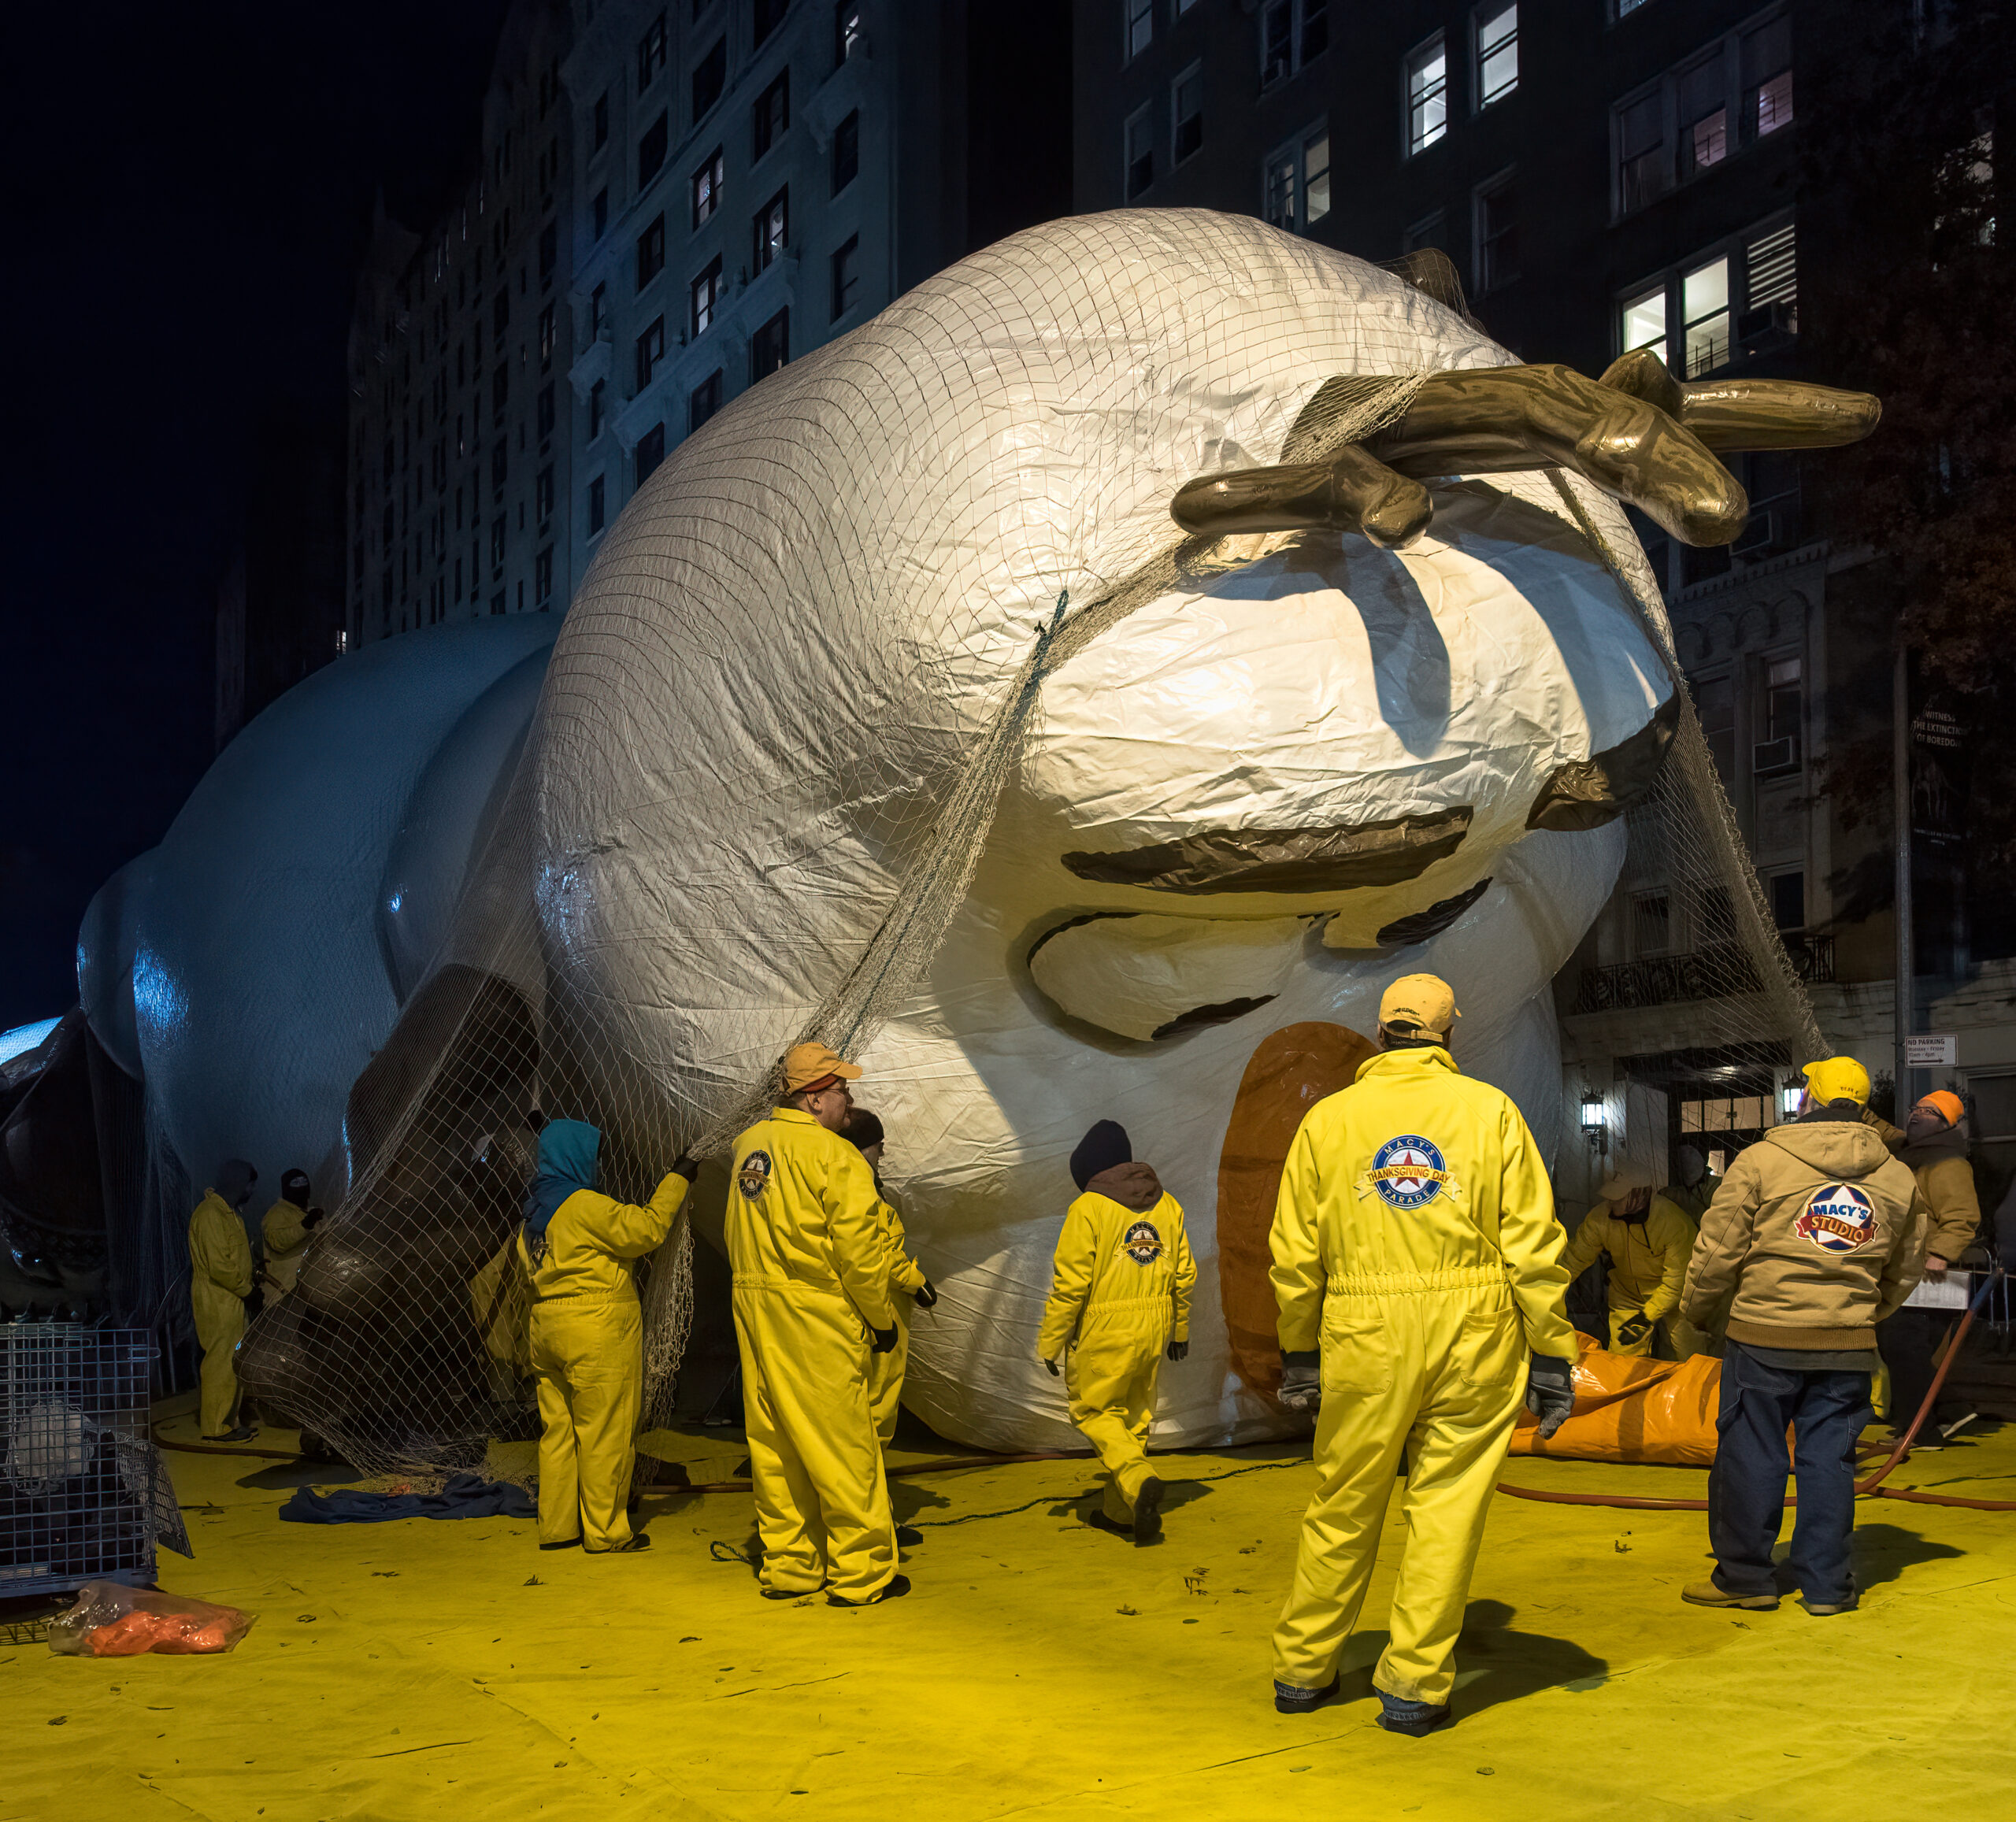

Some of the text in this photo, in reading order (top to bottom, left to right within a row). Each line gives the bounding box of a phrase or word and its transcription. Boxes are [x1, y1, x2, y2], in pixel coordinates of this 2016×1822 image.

[1913, 720, 1926, 730] THE
[1917, 733, 1926, 743] OF
[1384, 1139, 1436, 1156] MACY'S
[1367, 1167, 1451, 1183] THANKSGIVING DAY
[1384, 1190, 1430, 1204] PARADE
[1813, 1204, 1869, 1220] MACY'S
[1811, 1216, 1864, 1242] STUDIO
